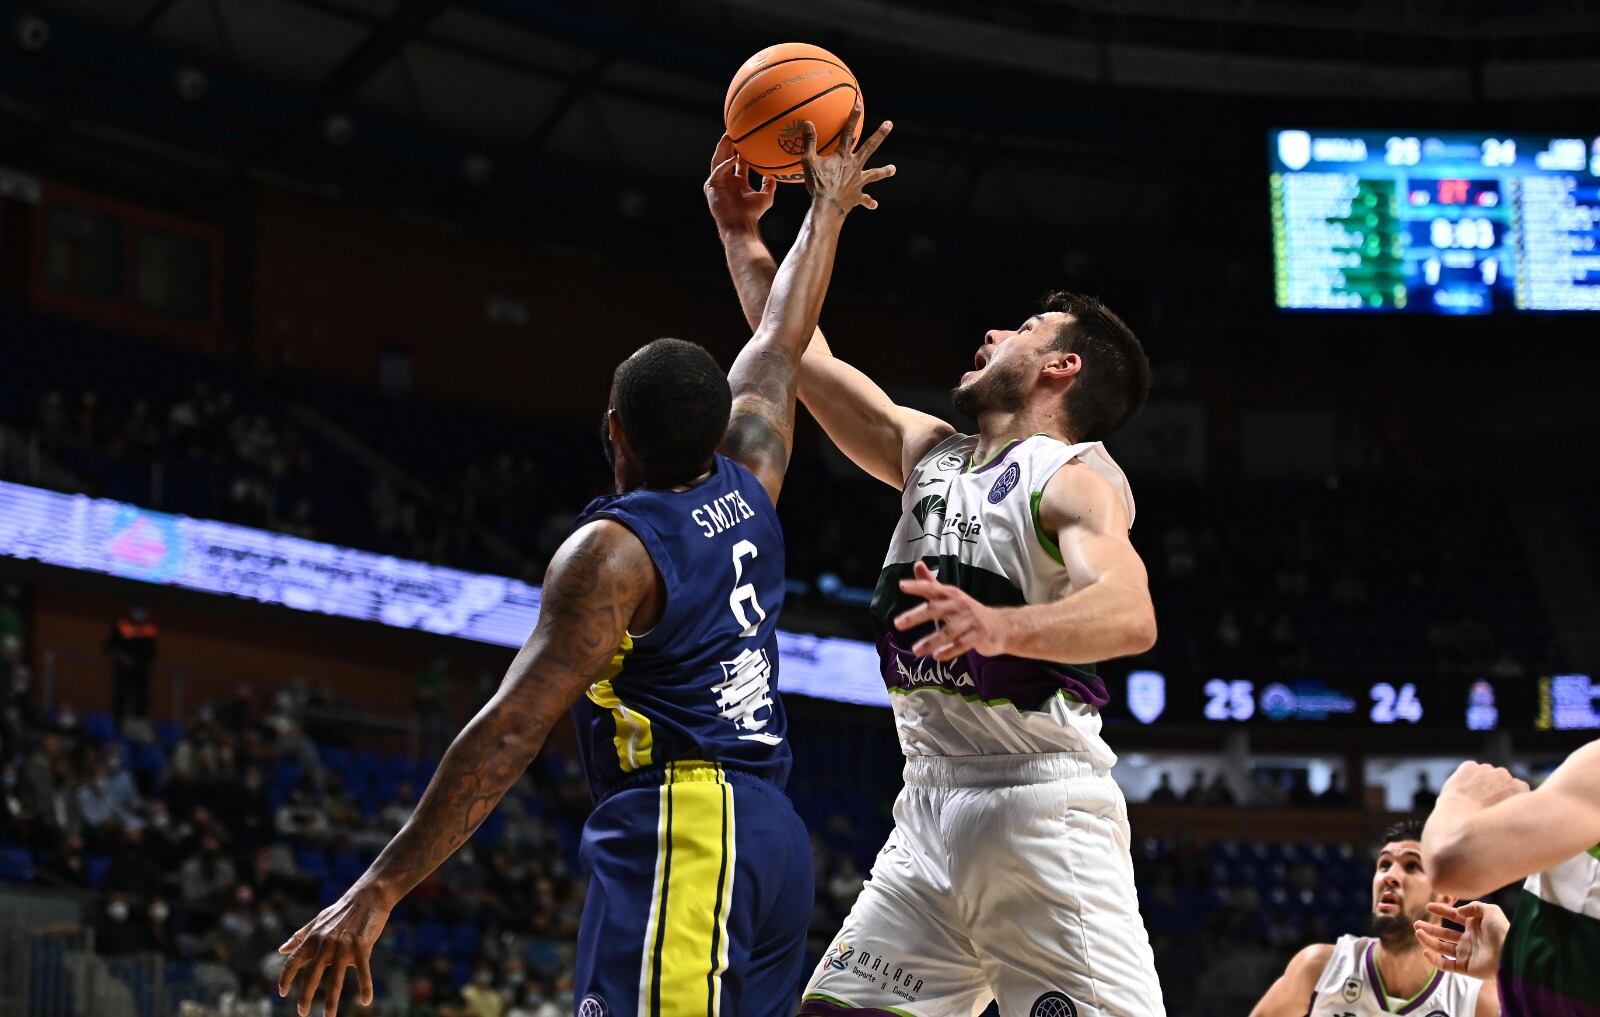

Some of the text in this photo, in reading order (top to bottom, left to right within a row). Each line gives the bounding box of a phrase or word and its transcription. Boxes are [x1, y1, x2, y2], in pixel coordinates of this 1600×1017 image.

[692, 490, 755, 538] SMITH
[730, 539, 766, 637] 6
[1203, 678, 1255, 721] 25
[1369, 682, 1423, 724] 24
[852, 966, 877, 983] Deporte
[892, 985, 916, 1003] Eventos
[857, 951, 923, 993] MÁLAGA
